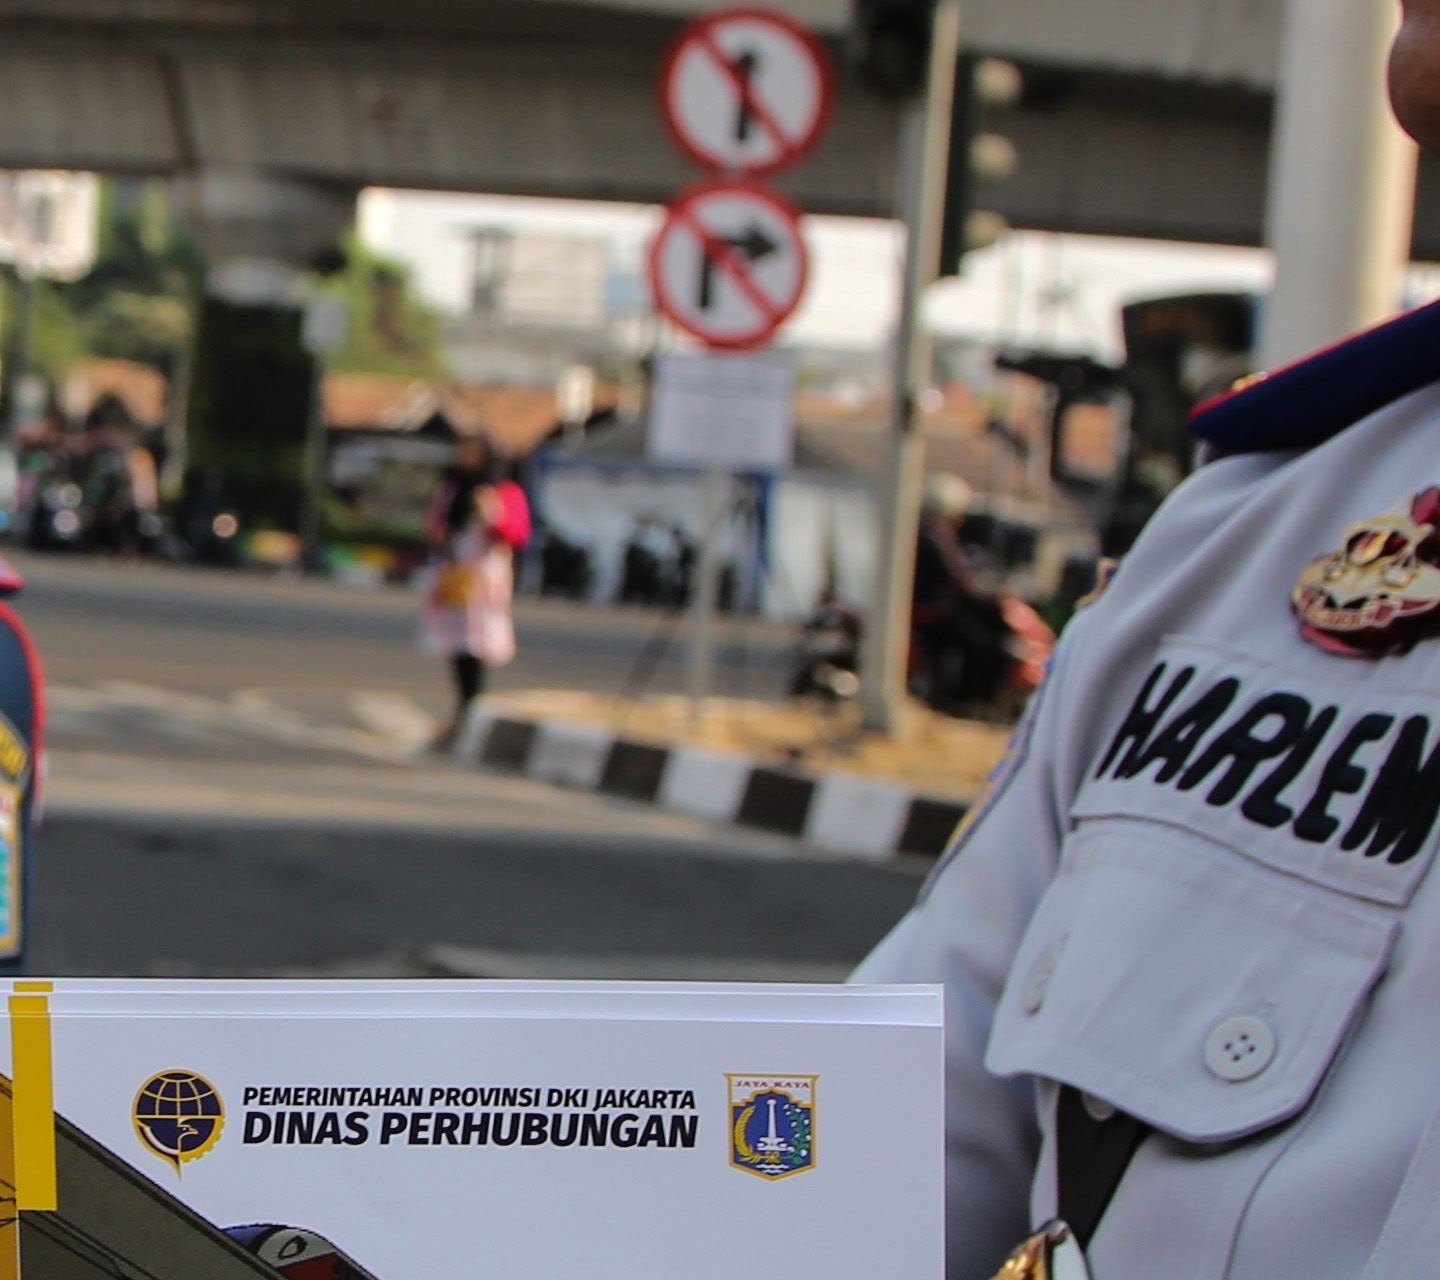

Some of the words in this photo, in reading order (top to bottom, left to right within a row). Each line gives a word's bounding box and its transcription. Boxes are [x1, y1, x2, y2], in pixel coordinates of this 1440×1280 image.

[733, 1080, 768, 1088] JAYA
[242, 1086, 424, 1107] PEMERINTAHAN
[428, 1087, 541, 1107] PROVINSI
[546, 1088, 589, 1108] DKI
[592, 1088, 696, 1112] JAKARTA
[242, 1110, 370, 1146] DINAS
[378, 1111, 699, 1148] PERHUBUNGAN
